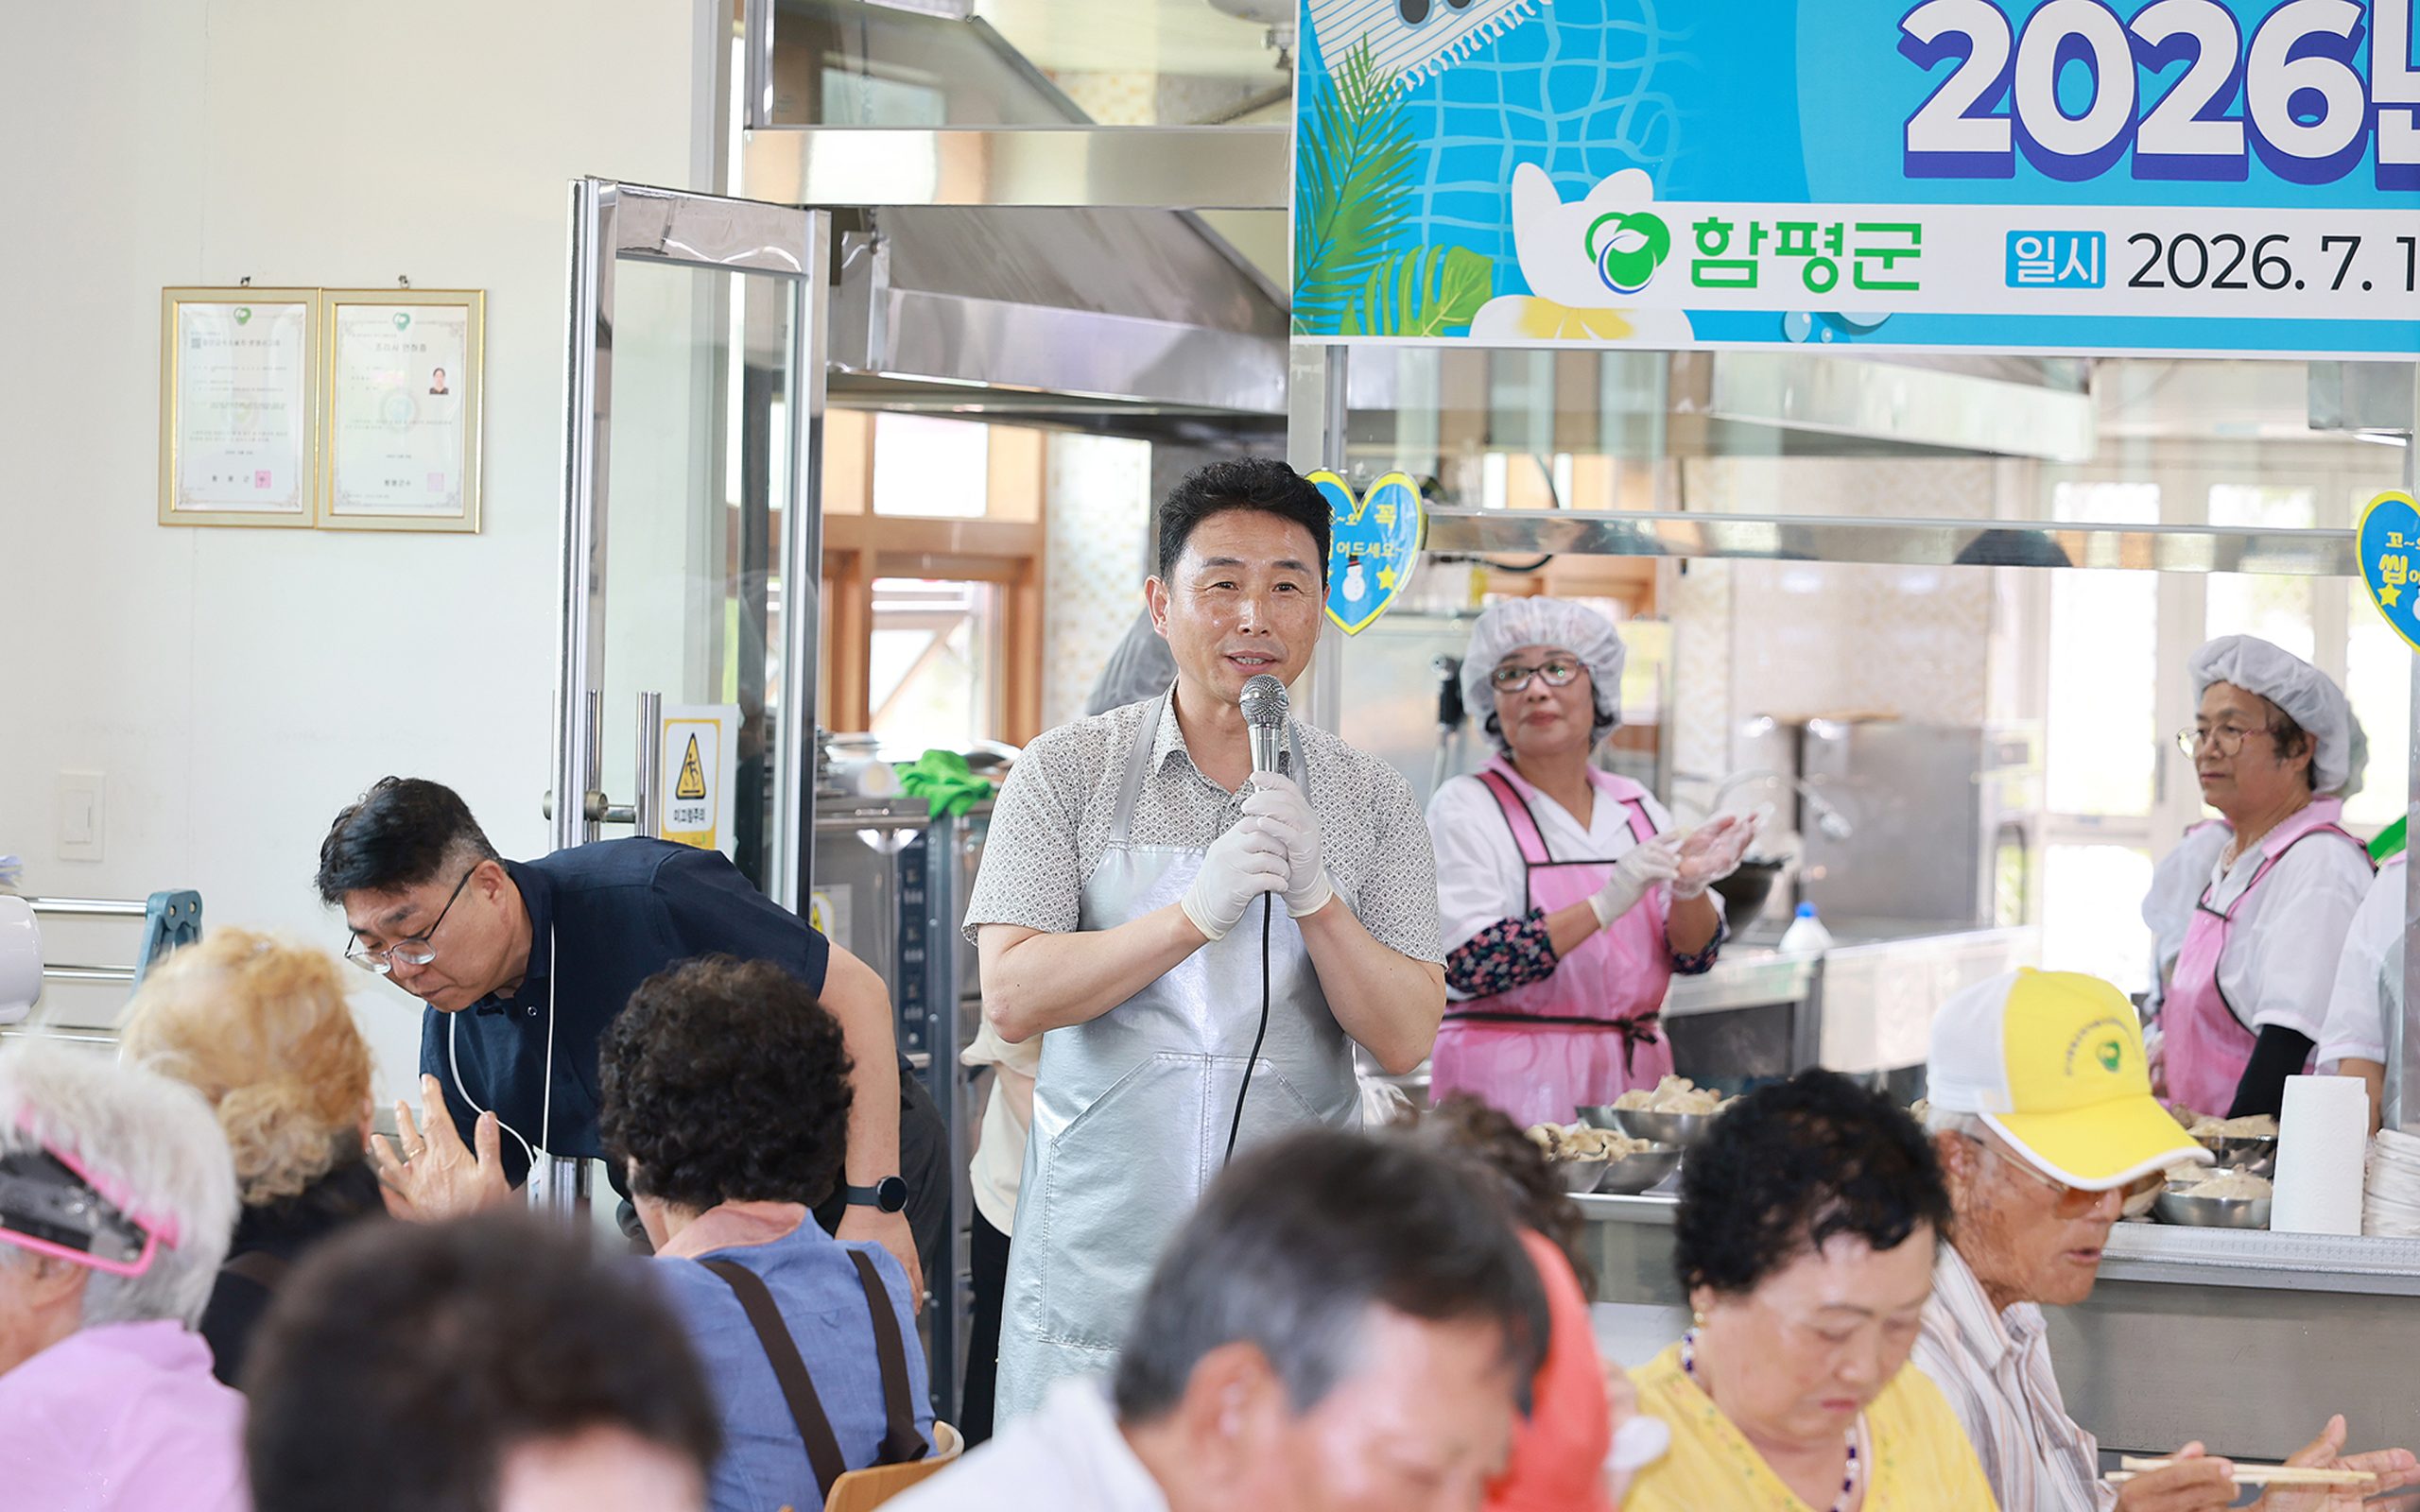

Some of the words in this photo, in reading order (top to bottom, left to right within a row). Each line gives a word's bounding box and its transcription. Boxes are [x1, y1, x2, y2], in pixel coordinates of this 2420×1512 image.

[1691, 216, 1923, 294] 함평군
[2014, 236, 2099, 284] 일시
[1374, 504, 1397, 530] 꼭
